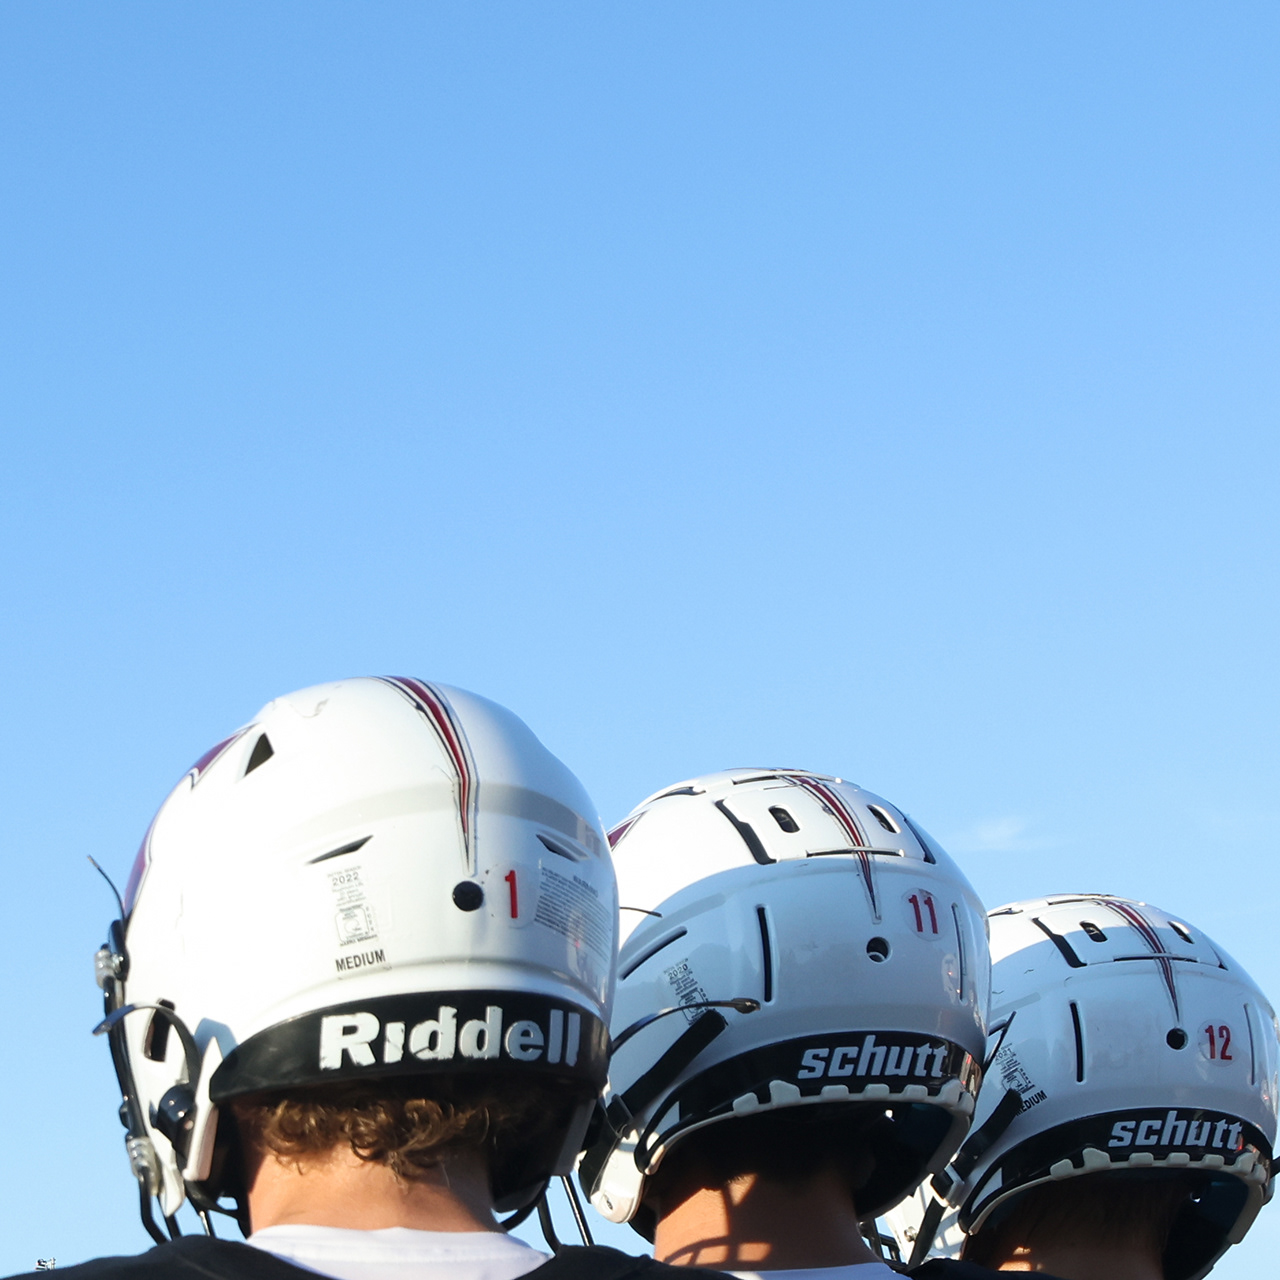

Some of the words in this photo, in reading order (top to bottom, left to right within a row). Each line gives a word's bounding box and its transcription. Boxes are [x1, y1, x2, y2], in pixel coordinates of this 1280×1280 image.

[505, 870, 518, 919] 1
[908, 894, 938, 934] 11
[335, 948, 386, 972] MEDIUM
[319, 1005, 581, 1071] Riddell
[797, 1034, 948, 1080] schutt
[1205, 1025, 1233, 1060] 12
[1108, 1110, 1243, 1151] schutt
